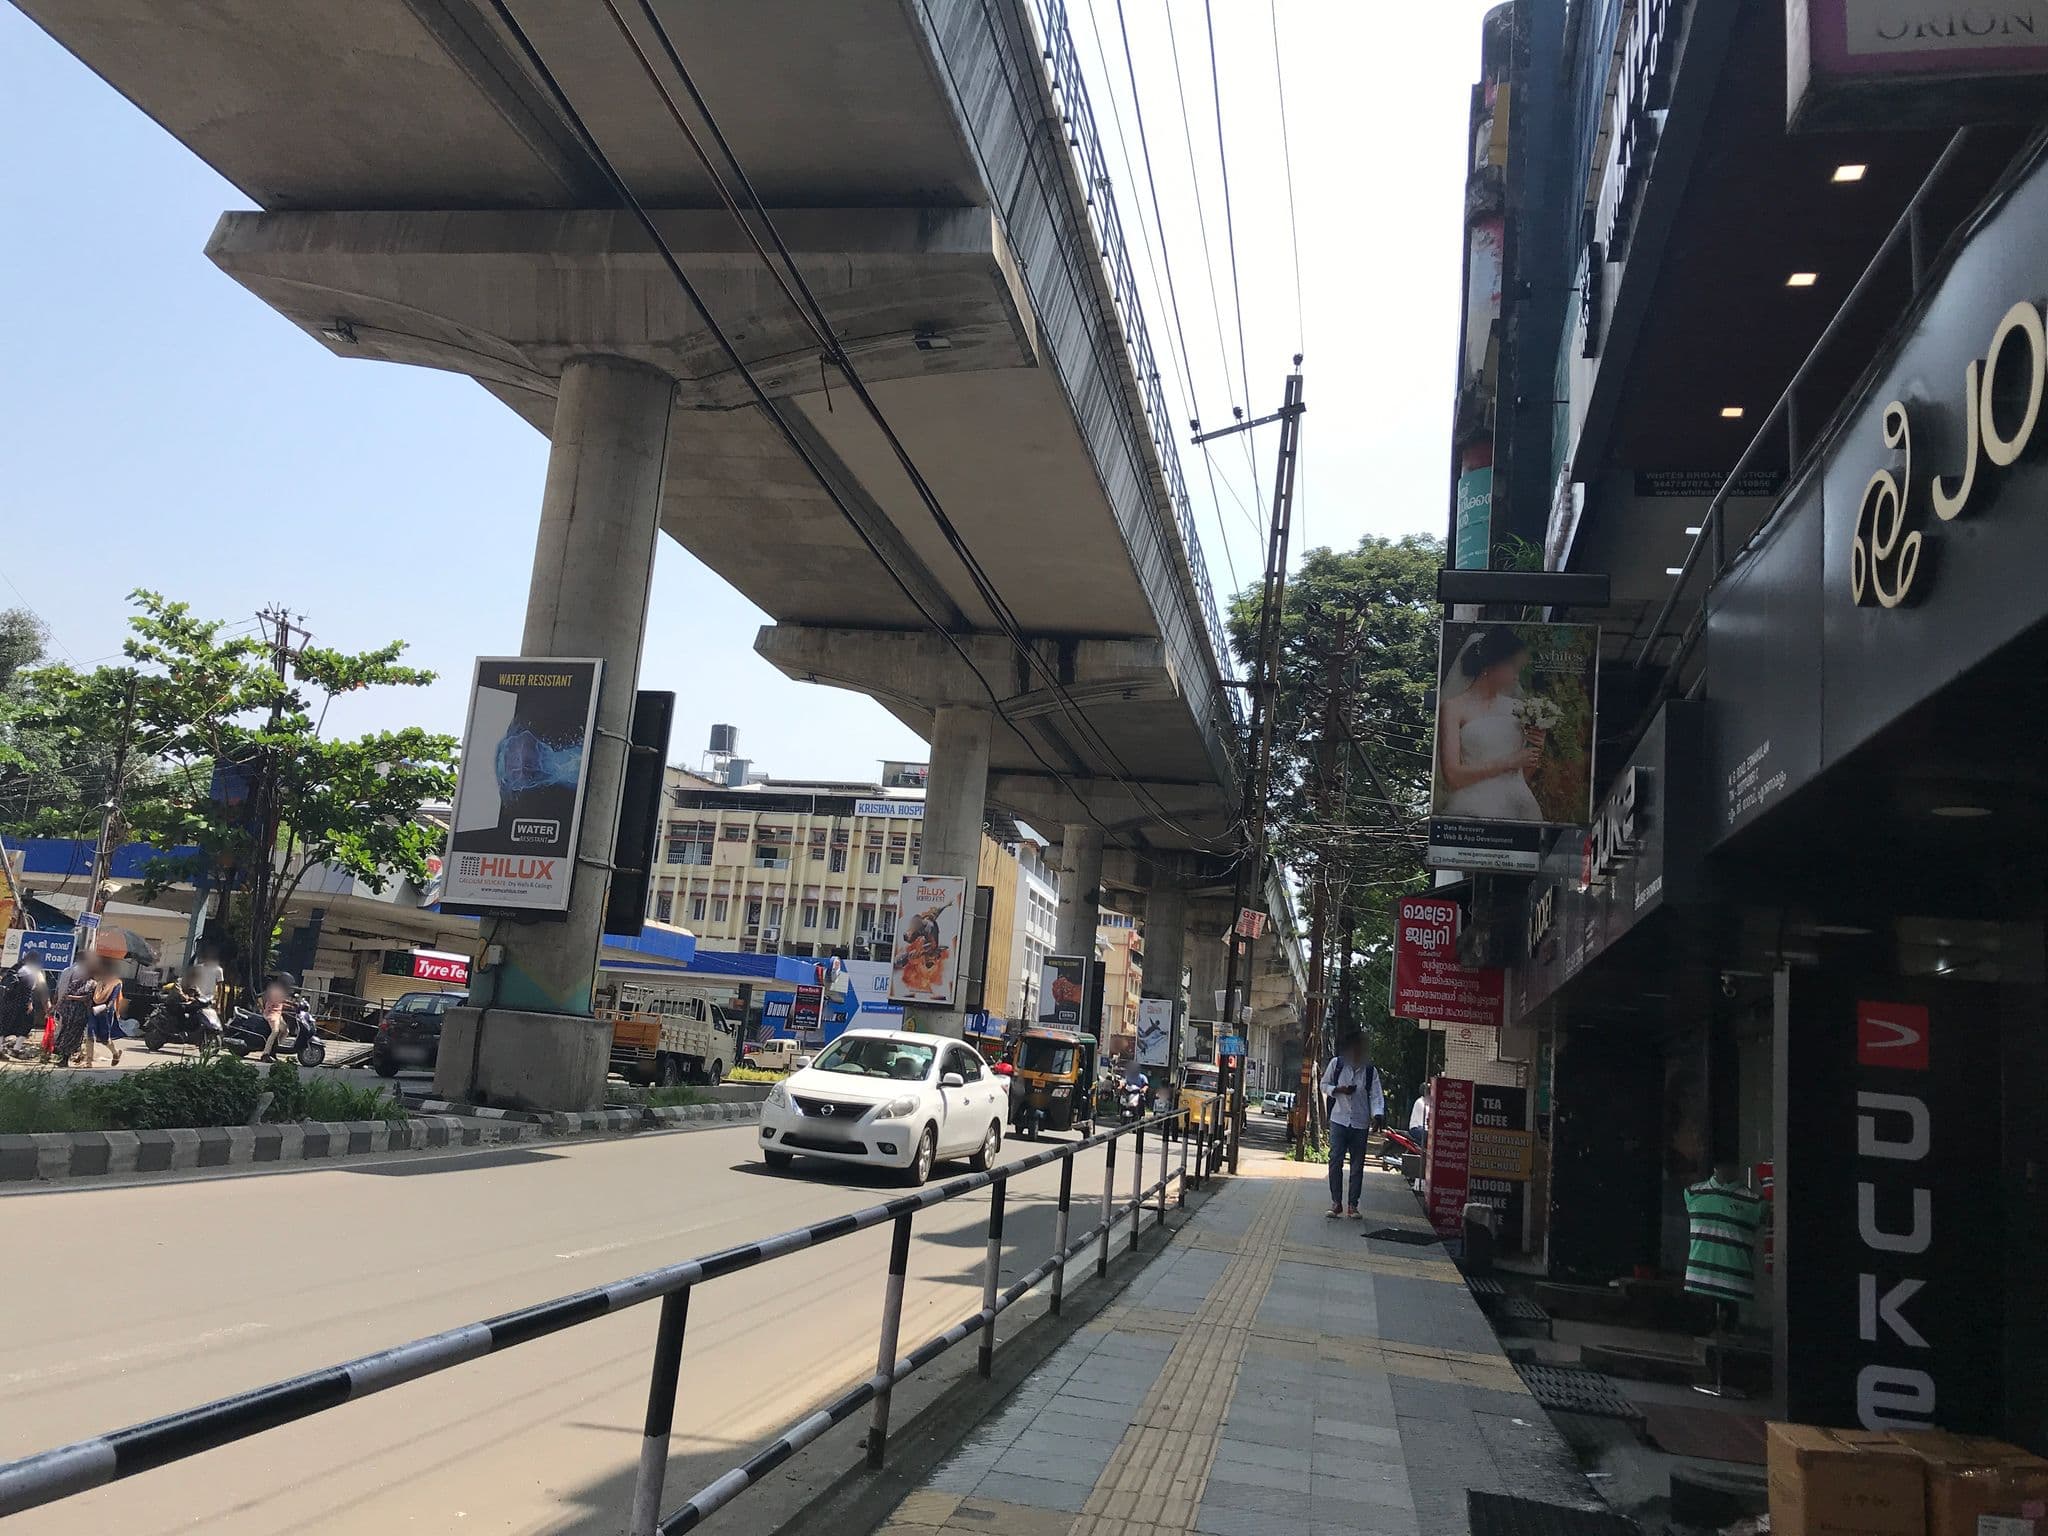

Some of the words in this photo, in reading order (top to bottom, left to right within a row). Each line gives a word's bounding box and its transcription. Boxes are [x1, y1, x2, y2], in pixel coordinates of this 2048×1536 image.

[1931, 300, 2048, 521] JO
[498, 673, 526, 686] WATER
[527, 674, 573, 687] RESISTANT
[858, 803, 896, 815] KRISHNA
[517, 825, 554, 835] WATER
[480, 857, 556, 880] HILUX
[917, 887, 946, 896] HILUX
[1243, 910, 1264, 922] GST
[1403, 904, 1453, 926] മെട്രോ
[45, 953, 68, 963] Road
[1481, 1096, 1502, 1110] TEA
[1475, 1114, 1509, 1128] COFEE
